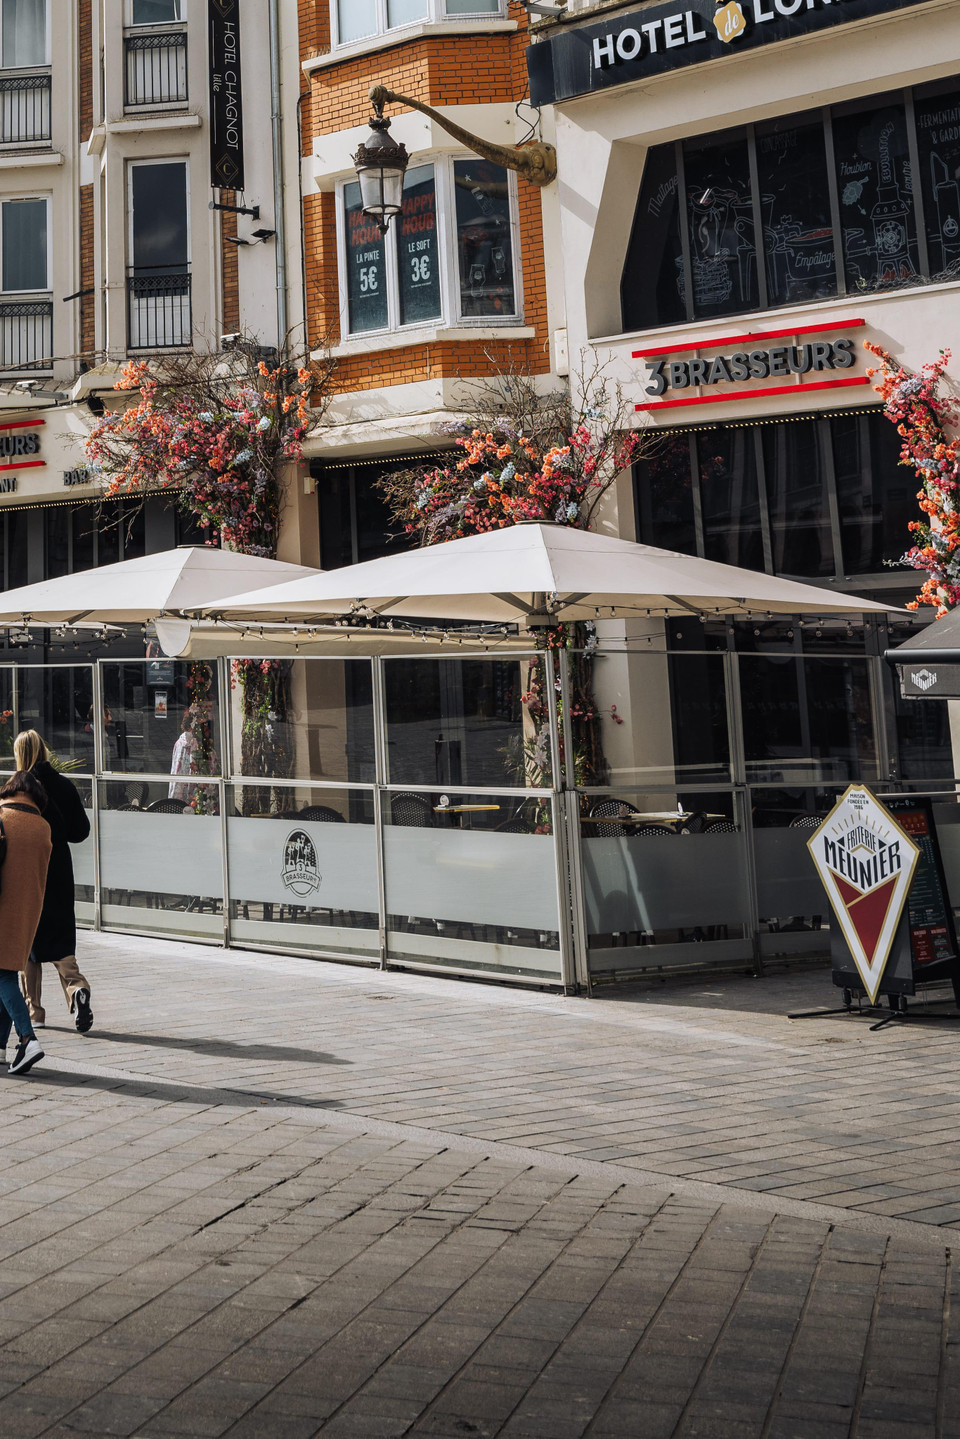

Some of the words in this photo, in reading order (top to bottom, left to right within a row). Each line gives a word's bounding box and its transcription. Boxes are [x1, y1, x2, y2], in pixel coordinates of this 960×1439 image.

[224, 21, 238, 65] HOTEL
[592, 9, 707, 69] HOTEL
[724, 9, 740, 37] de
[224, 70, 239, 150] CHAGNOT
[402, 212, 435, 236] HOUR
[356, 253, 364, 264] LA
[364, 250, 380, 262] PINTE
[408, 243, 416, 253] LE
[416, 239, 431, 252] SOFT
[411, 255, 431, 282] 3€
[795, 251, 836, 271] Empâtage
[359, 266, 378, 292] 5€
[911, 672, 938, 691] MEUNIER
[847, 826, 877, 852] FRITERIE
[824, 835, 902, 891] MEUNIER
